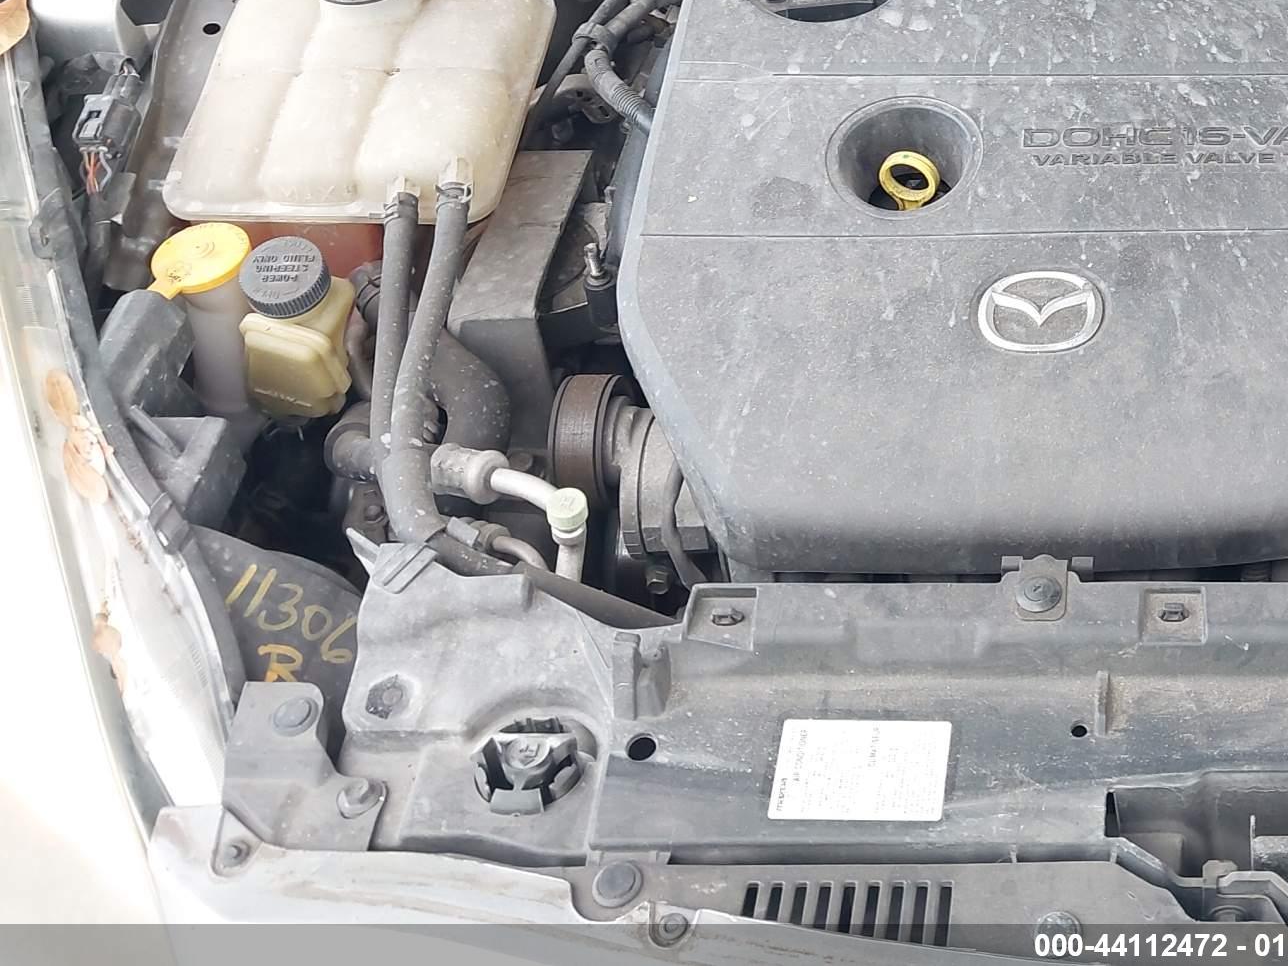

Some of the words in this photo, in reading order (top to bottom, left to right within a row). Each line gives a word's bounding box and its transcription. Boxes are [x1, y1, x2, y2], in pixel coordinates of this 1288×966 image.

[1023, 127, 1173, 147] DOHC
[1032, 152, 1179, 167] VARIABLE
[1185, 151, 1277, 165] VALVE
[283, 254, 316, 263] FLUID
[256, 264, 309, 273] STEERING
[261, 274, 298, 283] POWER
[225, 563, 358, 664] 11306
[257, 643, 303, 683] R
